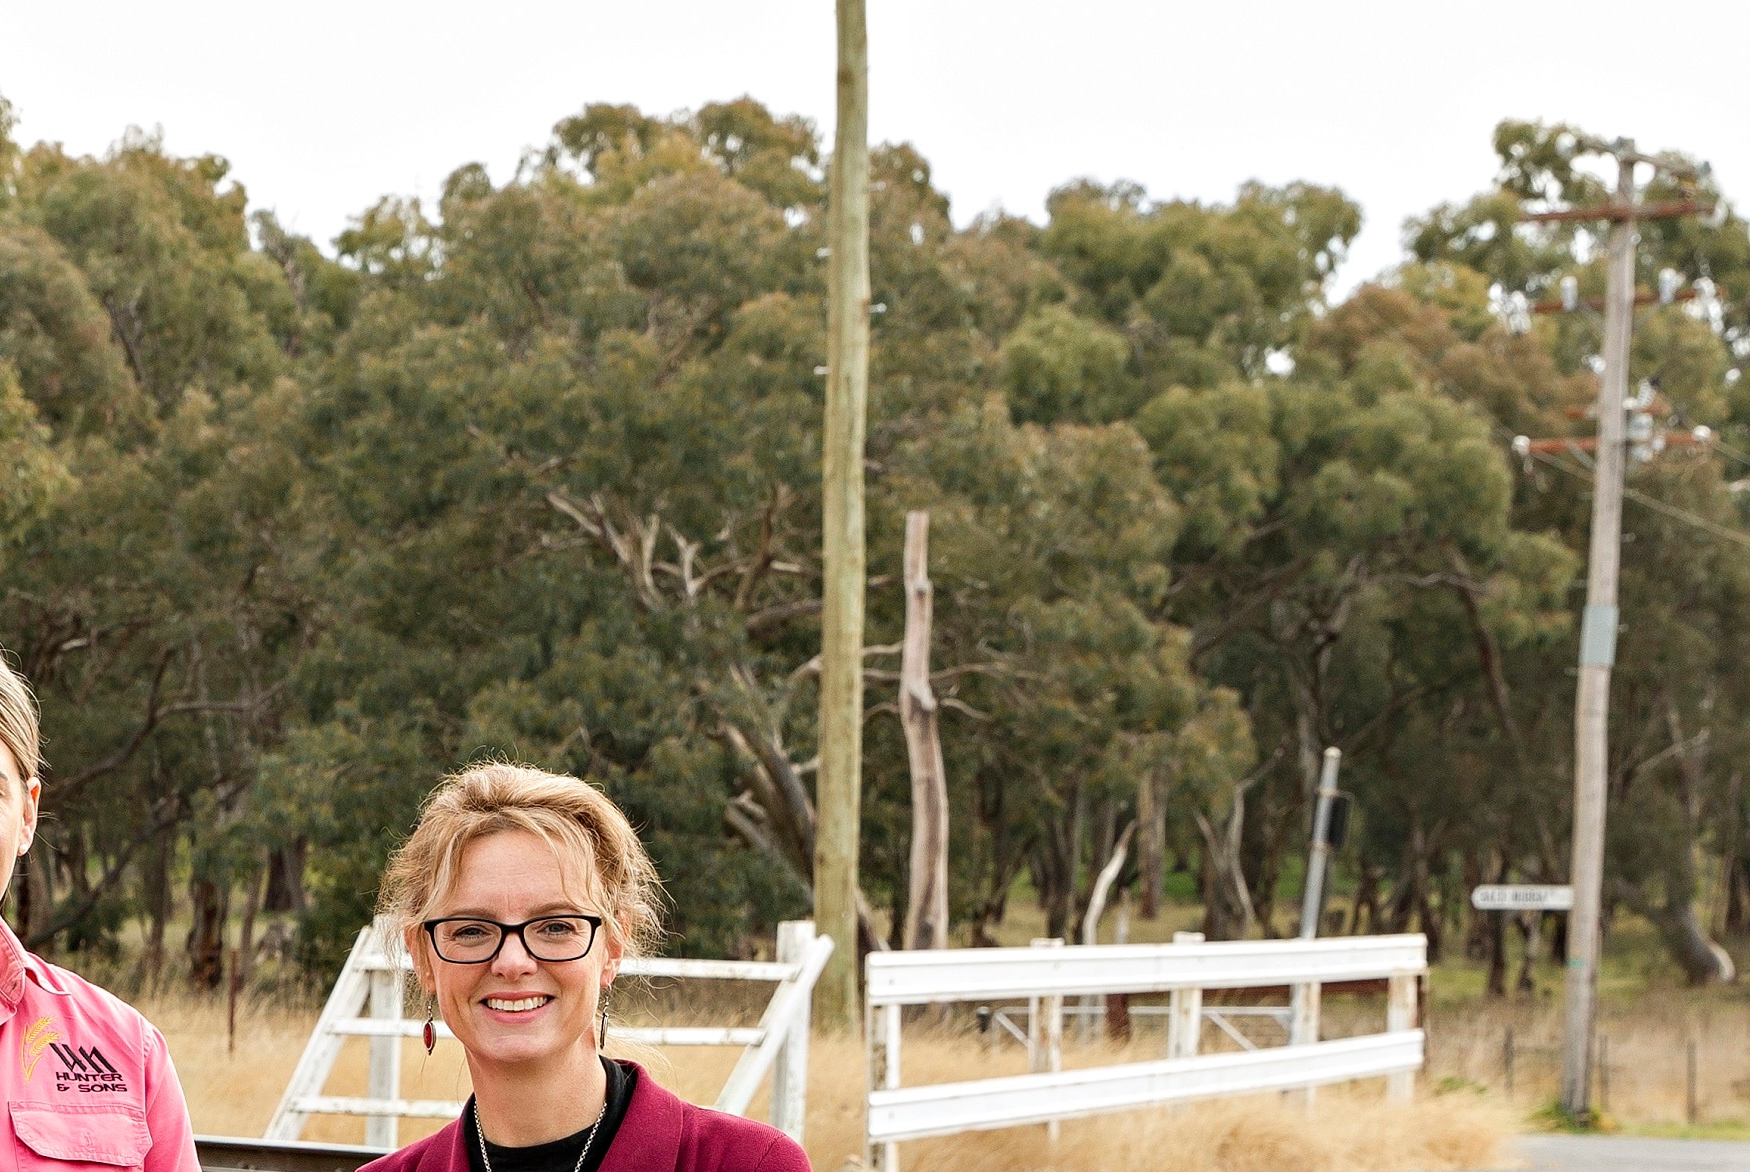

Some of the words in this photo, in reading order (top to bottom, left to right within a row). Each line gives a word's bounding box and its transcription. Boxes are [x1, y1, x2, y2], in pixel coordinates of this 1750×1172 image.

[55, 1071, 124, 1082] HUNTER
[56, 1083, 70, 1092] &
[77, 1083, 128, 1093] SONS
